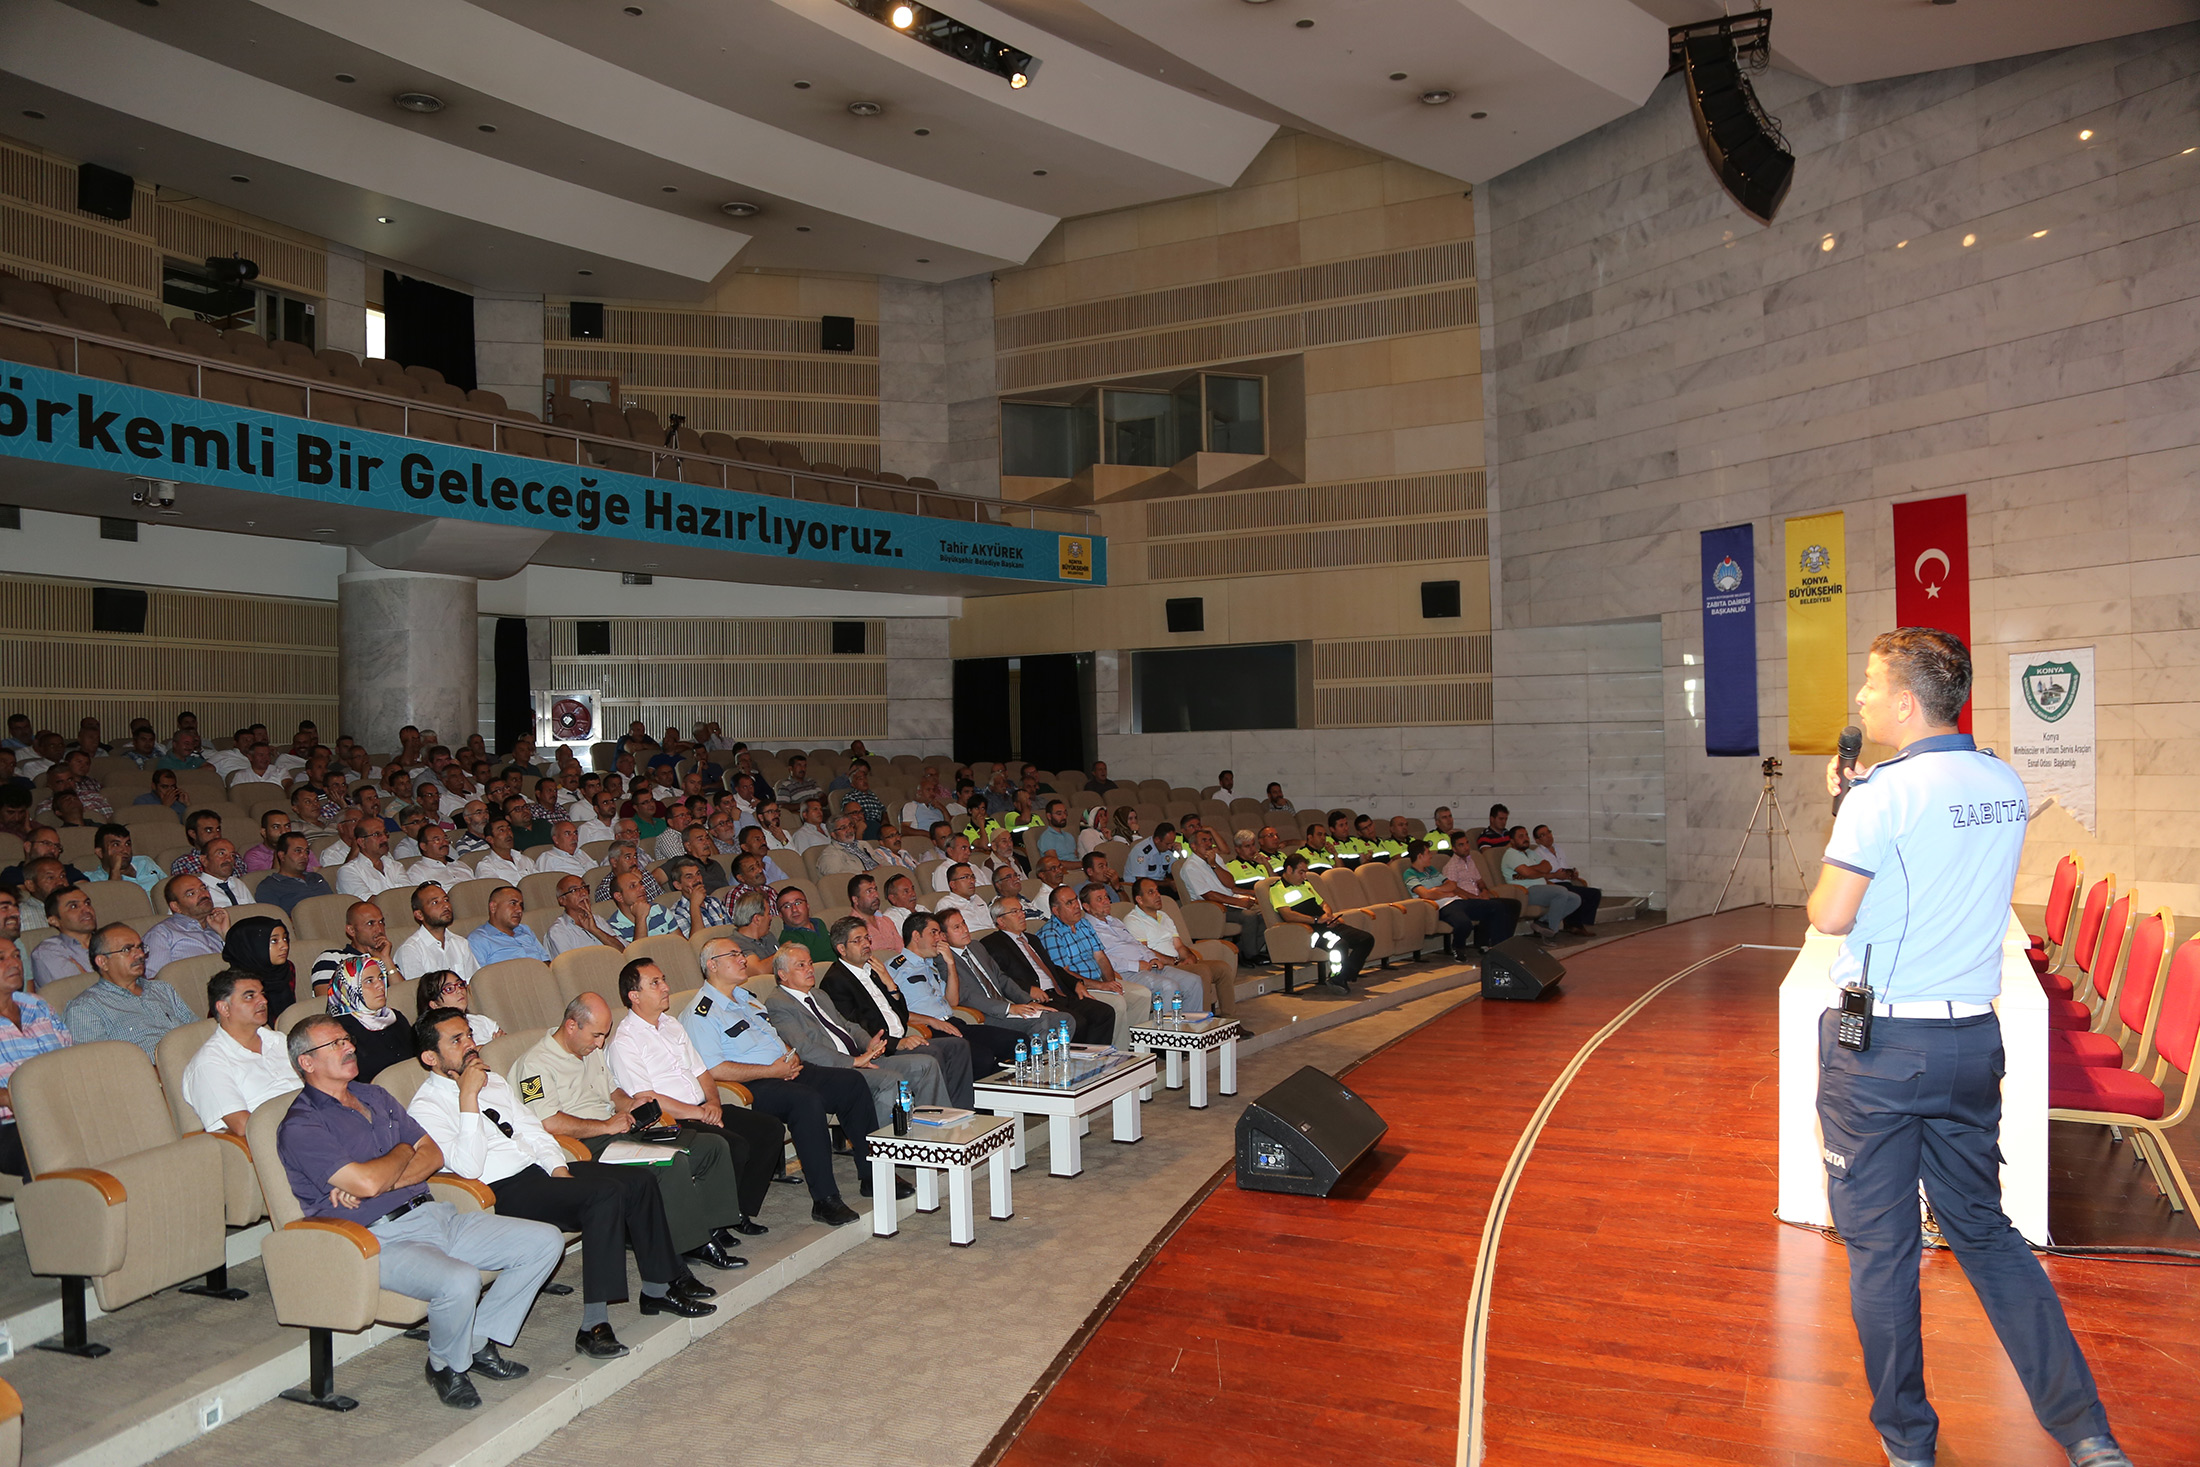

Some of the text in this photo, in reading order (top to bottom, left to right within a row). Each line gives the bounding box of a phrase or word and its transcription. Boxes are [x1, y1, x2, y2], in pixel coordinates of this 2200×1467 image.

[297, 433, 384, 491] Bir
[400, 453, 630, 531] Geleceğe
[645, 489, 903, 557] Hazırlıyoruz.
[940, 540, 1023, 559] Tahir AKYÜREK
[1802, 576, 1828, 586] KONYA
[1789, 583, 1843, 598] BÜYÜKŞEHİR
[1727, 597, 1751, 606] DAİRESİ
[1711, 606, 1747, 615] BAŞKANLIĞI
[2036, 667, 2064, 675] KONYA
[2043, 733, 2059, 743] Konya
[2046, 746, 2059, 754] Umum
[2060, 745, 2073, 754] Servis
[2054, 758, 2076, 769] Başkanlığı
[1949, 799, 2026, 828] ZABITA
